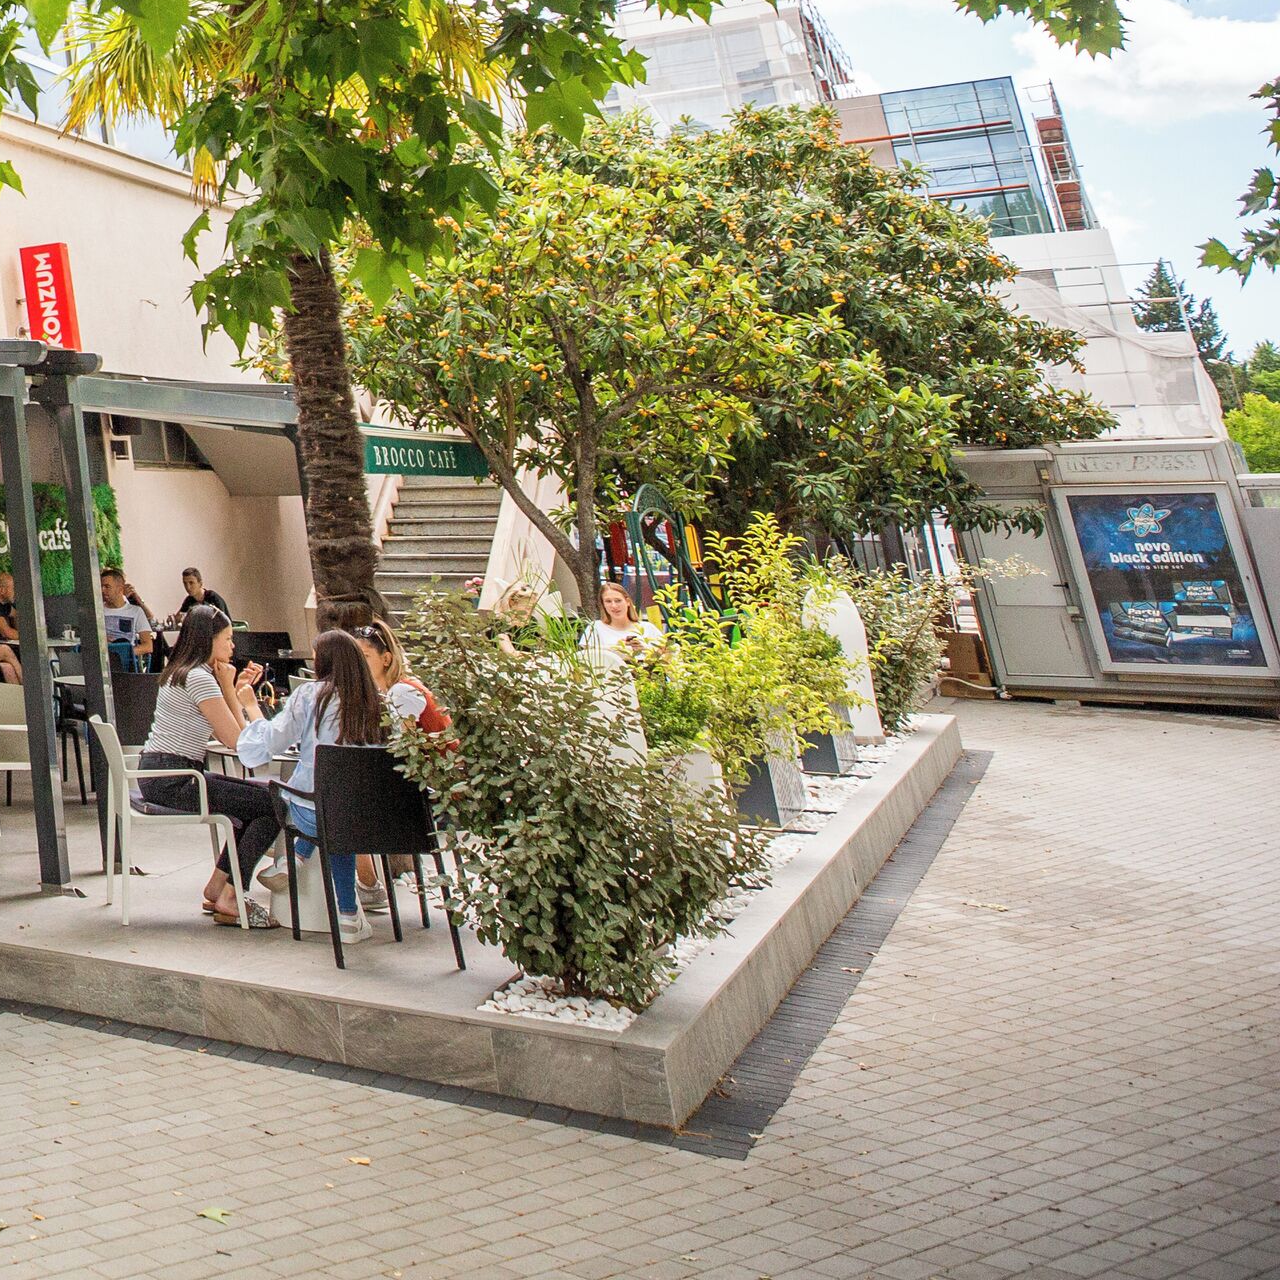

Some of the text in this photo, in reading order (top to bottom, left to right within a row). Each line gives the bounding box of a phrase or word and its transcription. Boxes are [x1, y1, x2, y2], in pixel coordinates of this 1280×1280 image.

[33, 252, 64, 348] KONZUM
[373, 445, 457, 469] BROCCO CAFÉ
[38, 518, 71, 551] café
[1134, 542, 1171, 552] novo
[1109, 551, 1204, 563] black edition
[1128, 608, 1161, 617] Party
